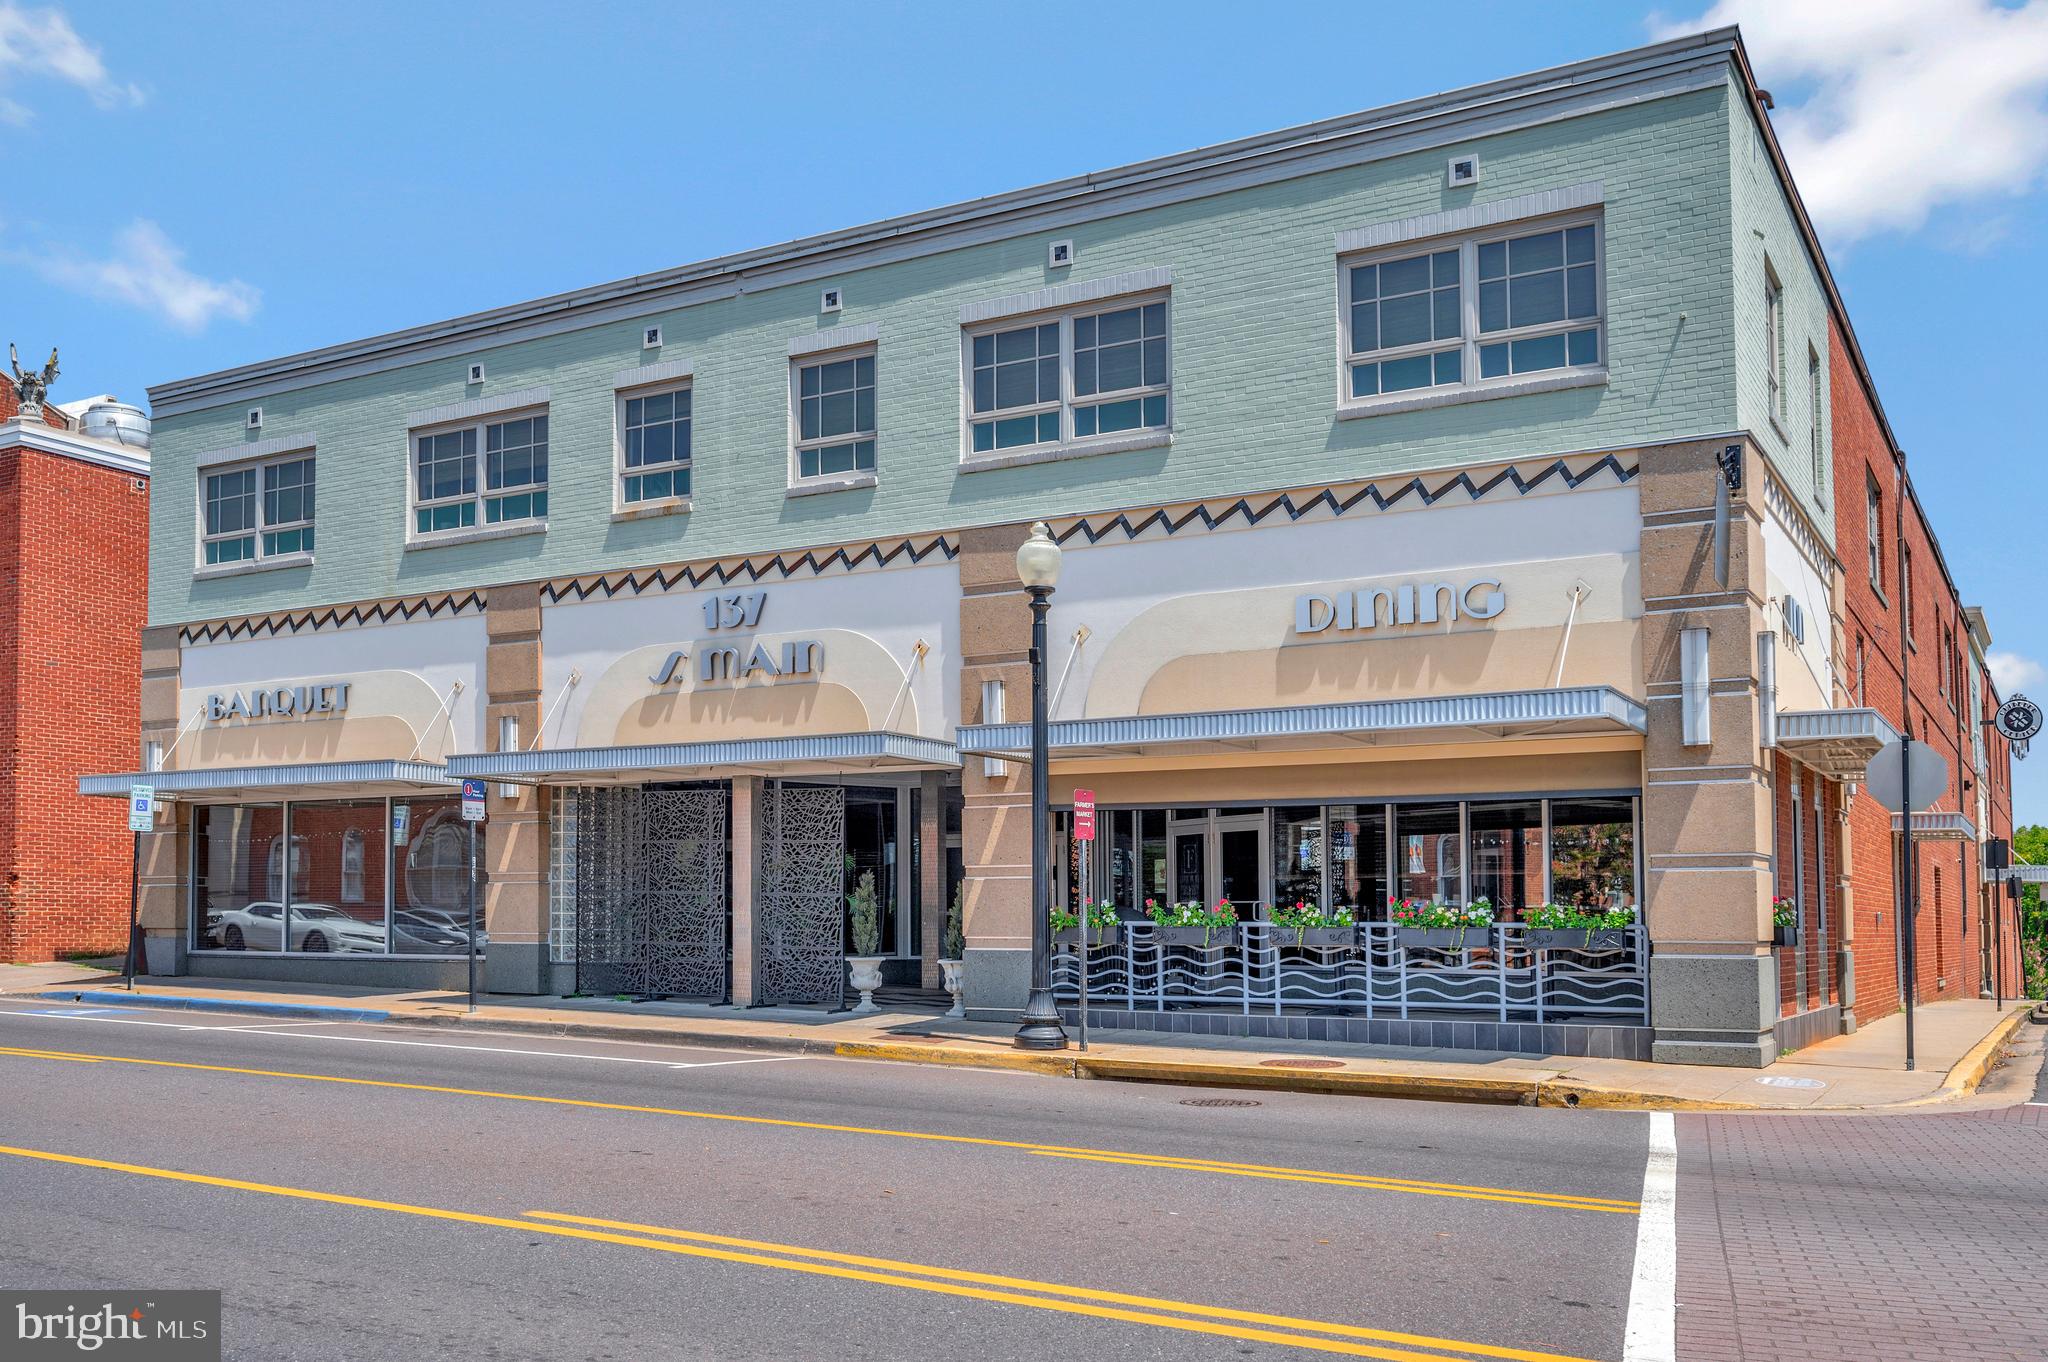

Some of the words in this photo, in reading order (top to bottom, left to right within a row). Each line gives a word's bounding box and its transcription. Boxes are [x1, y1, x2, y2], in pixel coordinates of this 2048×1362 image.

[703, 592, 767, 629] 137
[1296, 578, 1505, 633] DINING
[648, 649, 688, 685] S.
[701, 640, 824, 681] MAIN
[207, 682, 352, 721] BANQUET
